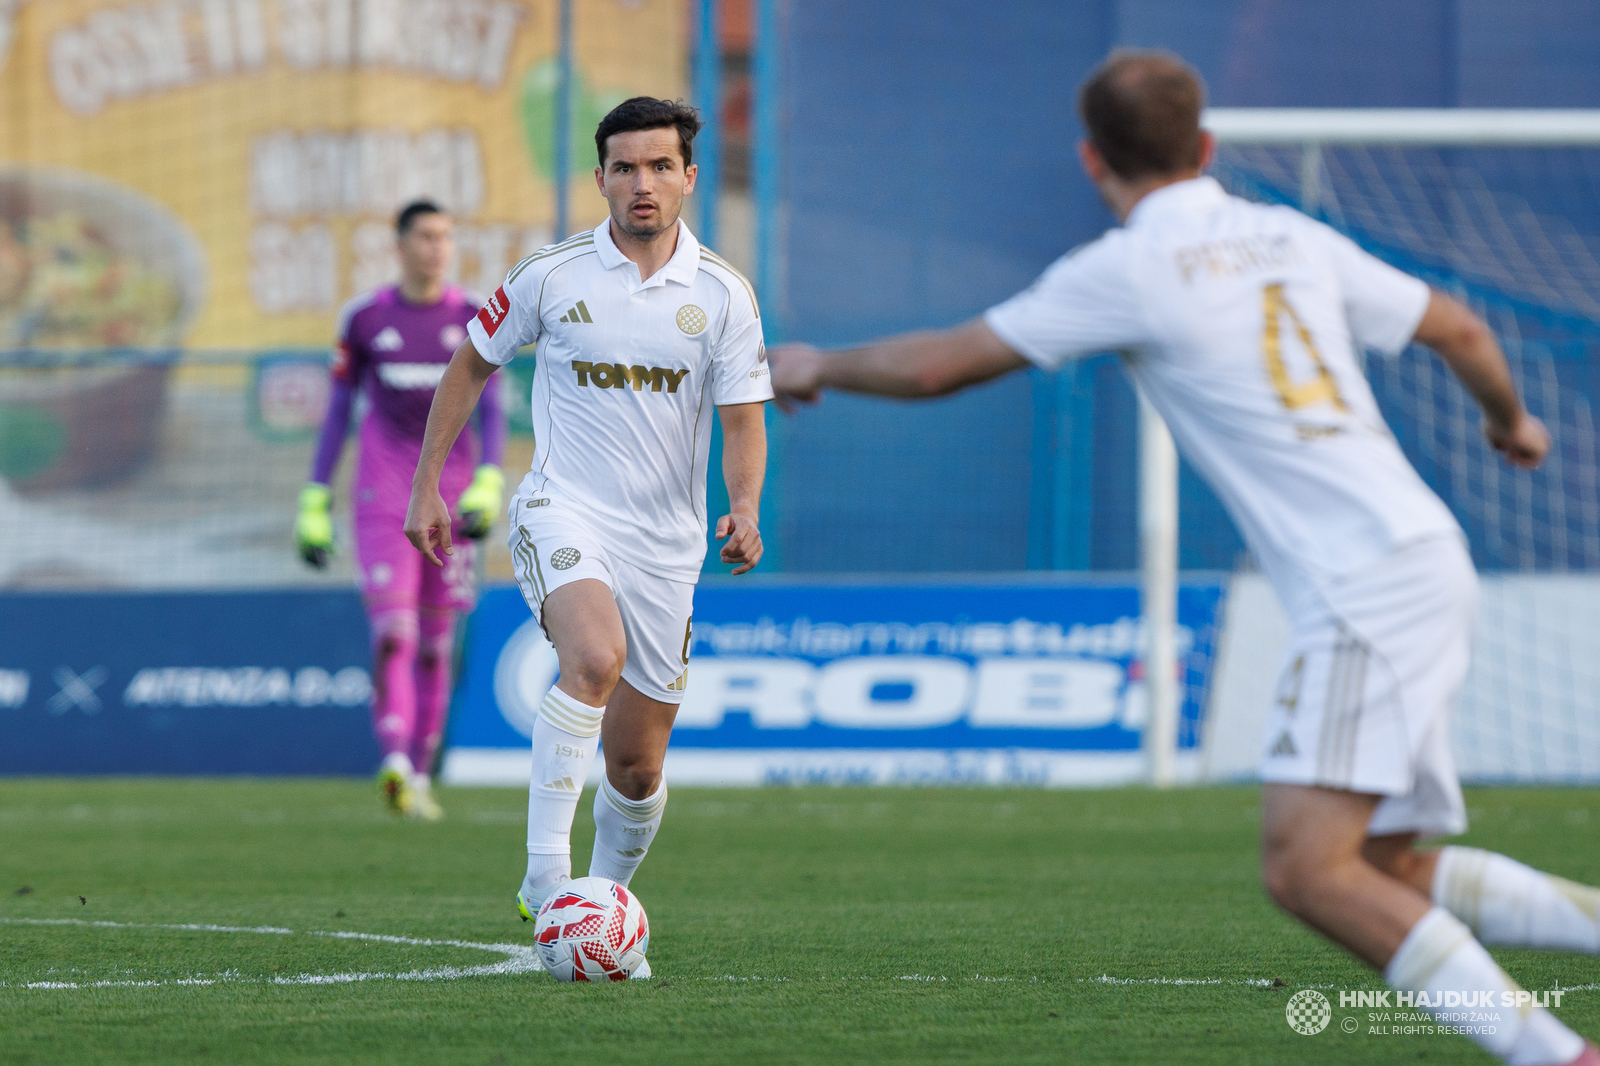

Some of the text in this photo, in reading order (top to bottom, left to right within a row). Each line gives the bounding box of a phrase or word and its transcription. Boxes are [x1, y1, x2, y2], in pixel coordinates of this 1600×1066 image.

[1262, 281, 1351, 414] 4
[572, 360, 690, 394] TOMMY
[555, 743, 584, 759] 1911
[622, 824, 653, 836] 1911
